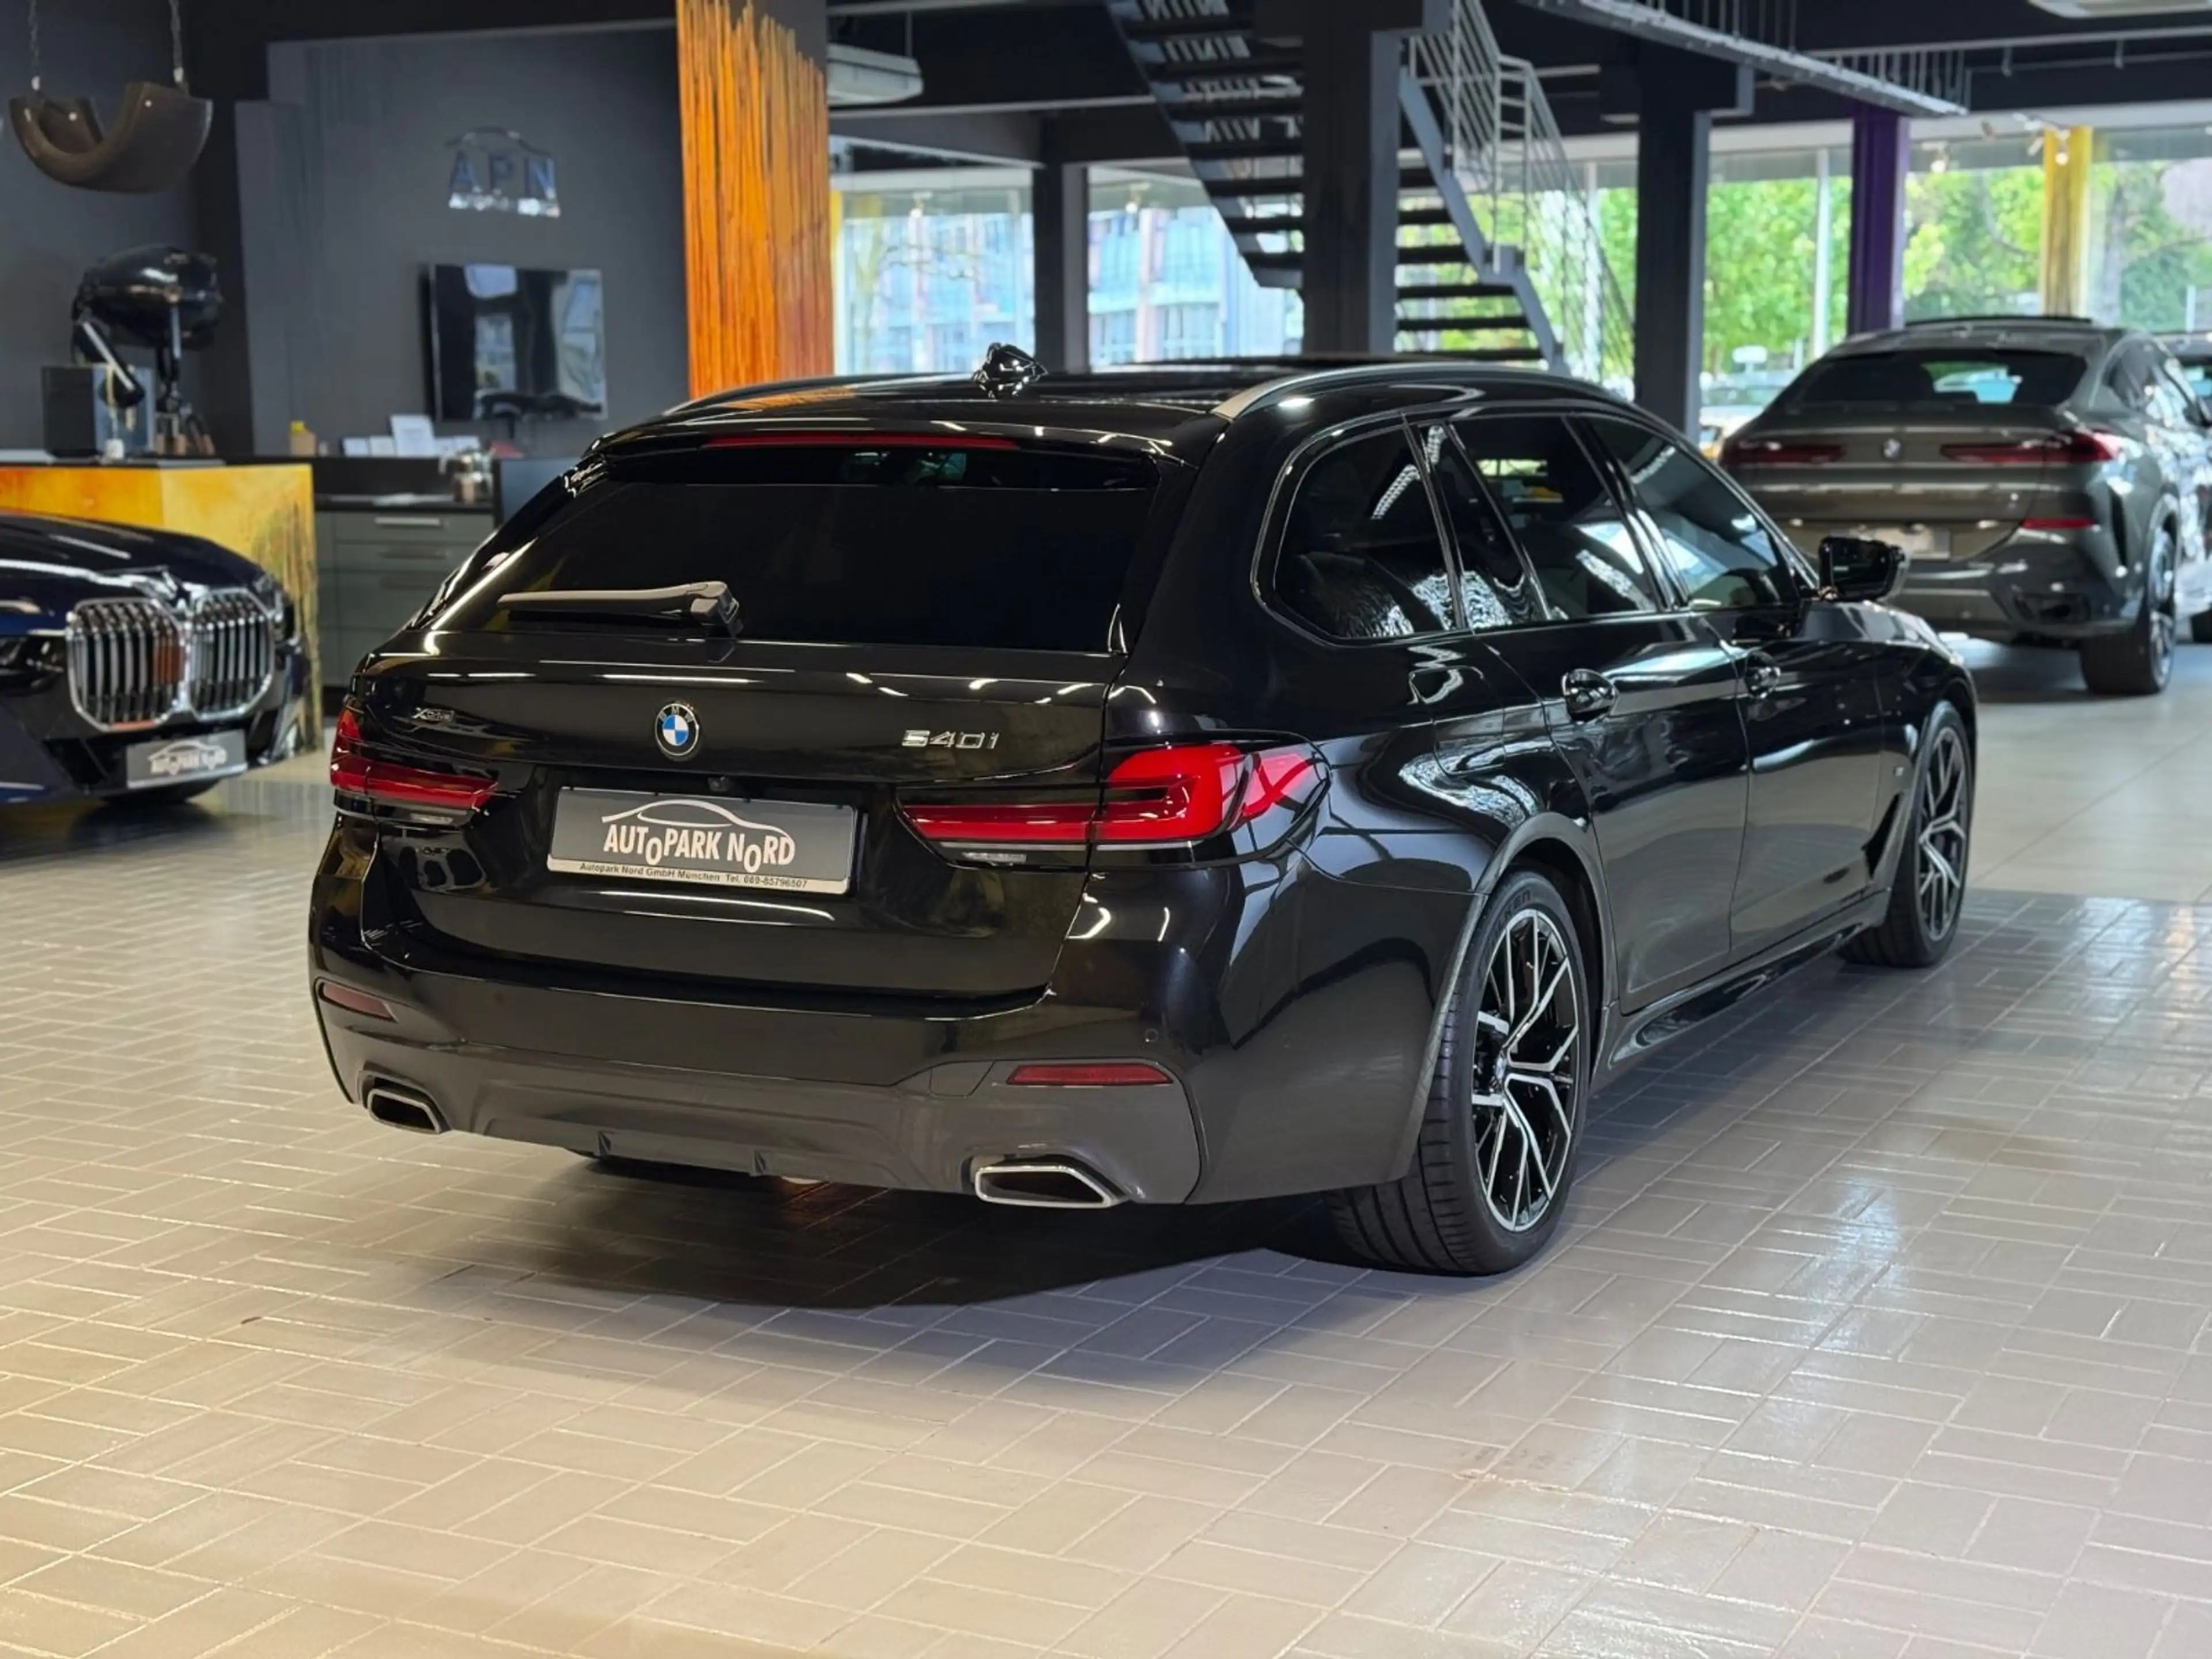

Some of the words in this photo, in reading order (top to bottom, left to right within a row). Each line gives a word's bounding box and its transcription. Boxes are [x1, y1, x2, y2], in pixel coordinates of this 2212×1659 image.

[449, 150, 556, 200] APN
[902, 730, 999, 749] 540i
[603, 824, 722, 865] AUTOPARK
[728, 833, 795, 873] NORD
[580, 863, 619, 873] Autopark
[622, 866, 643, 874] Nord
[646, 868, 675, 877] GmbH
